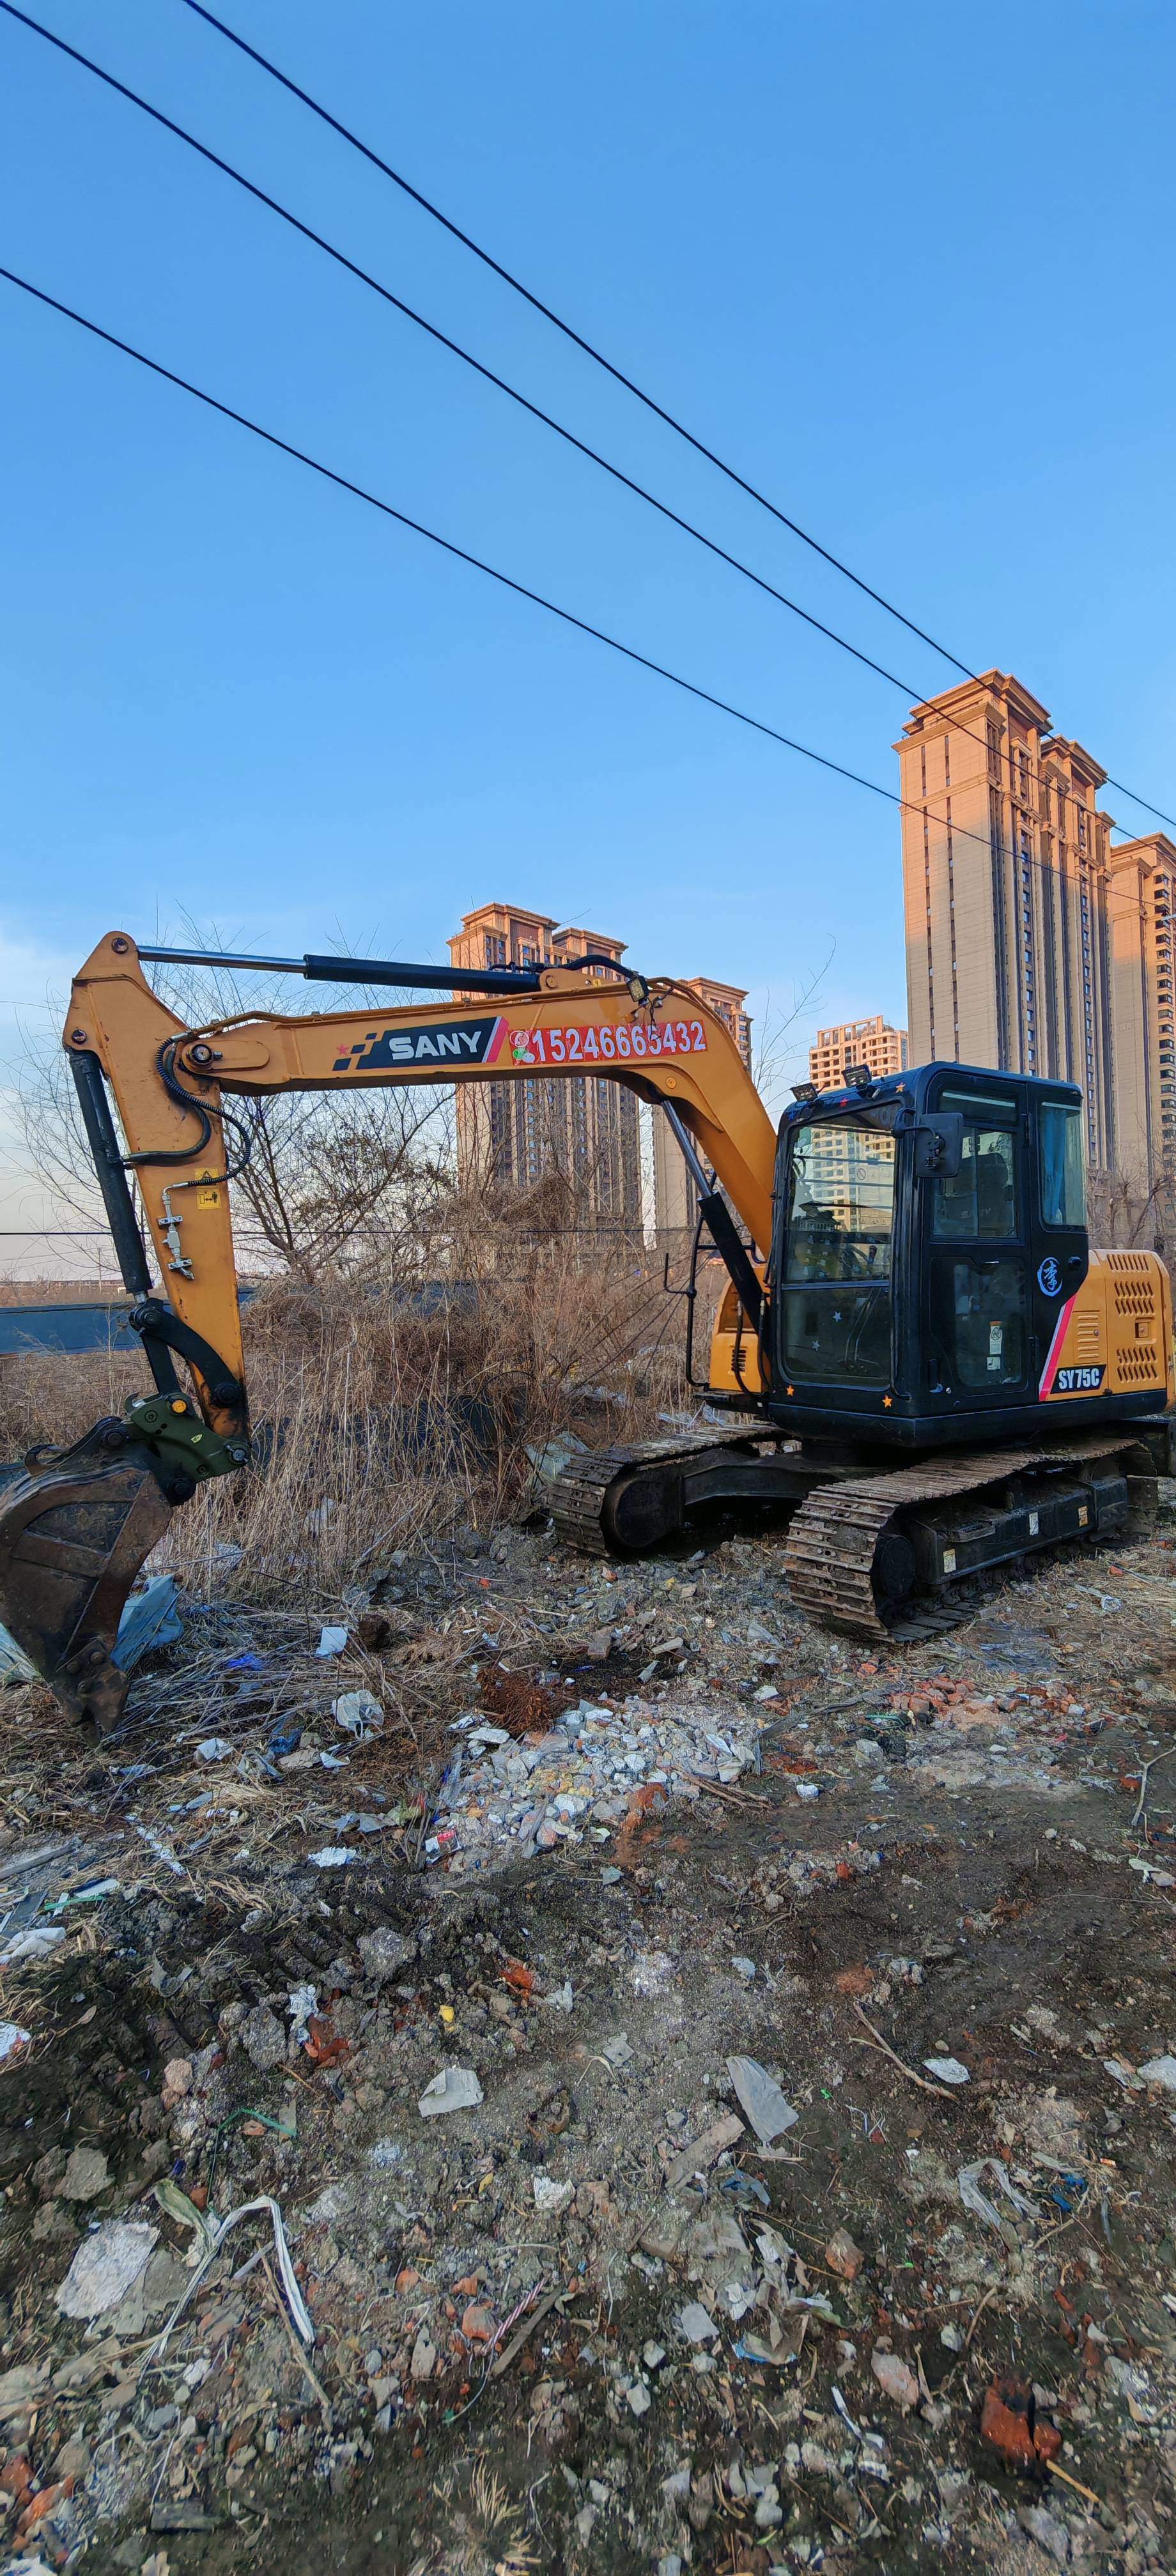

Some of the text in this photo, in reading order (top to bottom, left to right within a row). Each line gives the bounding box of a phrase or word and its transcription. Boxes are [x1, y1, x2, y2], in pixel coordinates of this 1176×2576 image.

[389, 1031, 482, 1060] SANY
[532, 1022, 706, 1062] 15246665432
[1044, 1261, 1058, 1291] 李
[1058, 1368, 1100, 1390] SY75C
